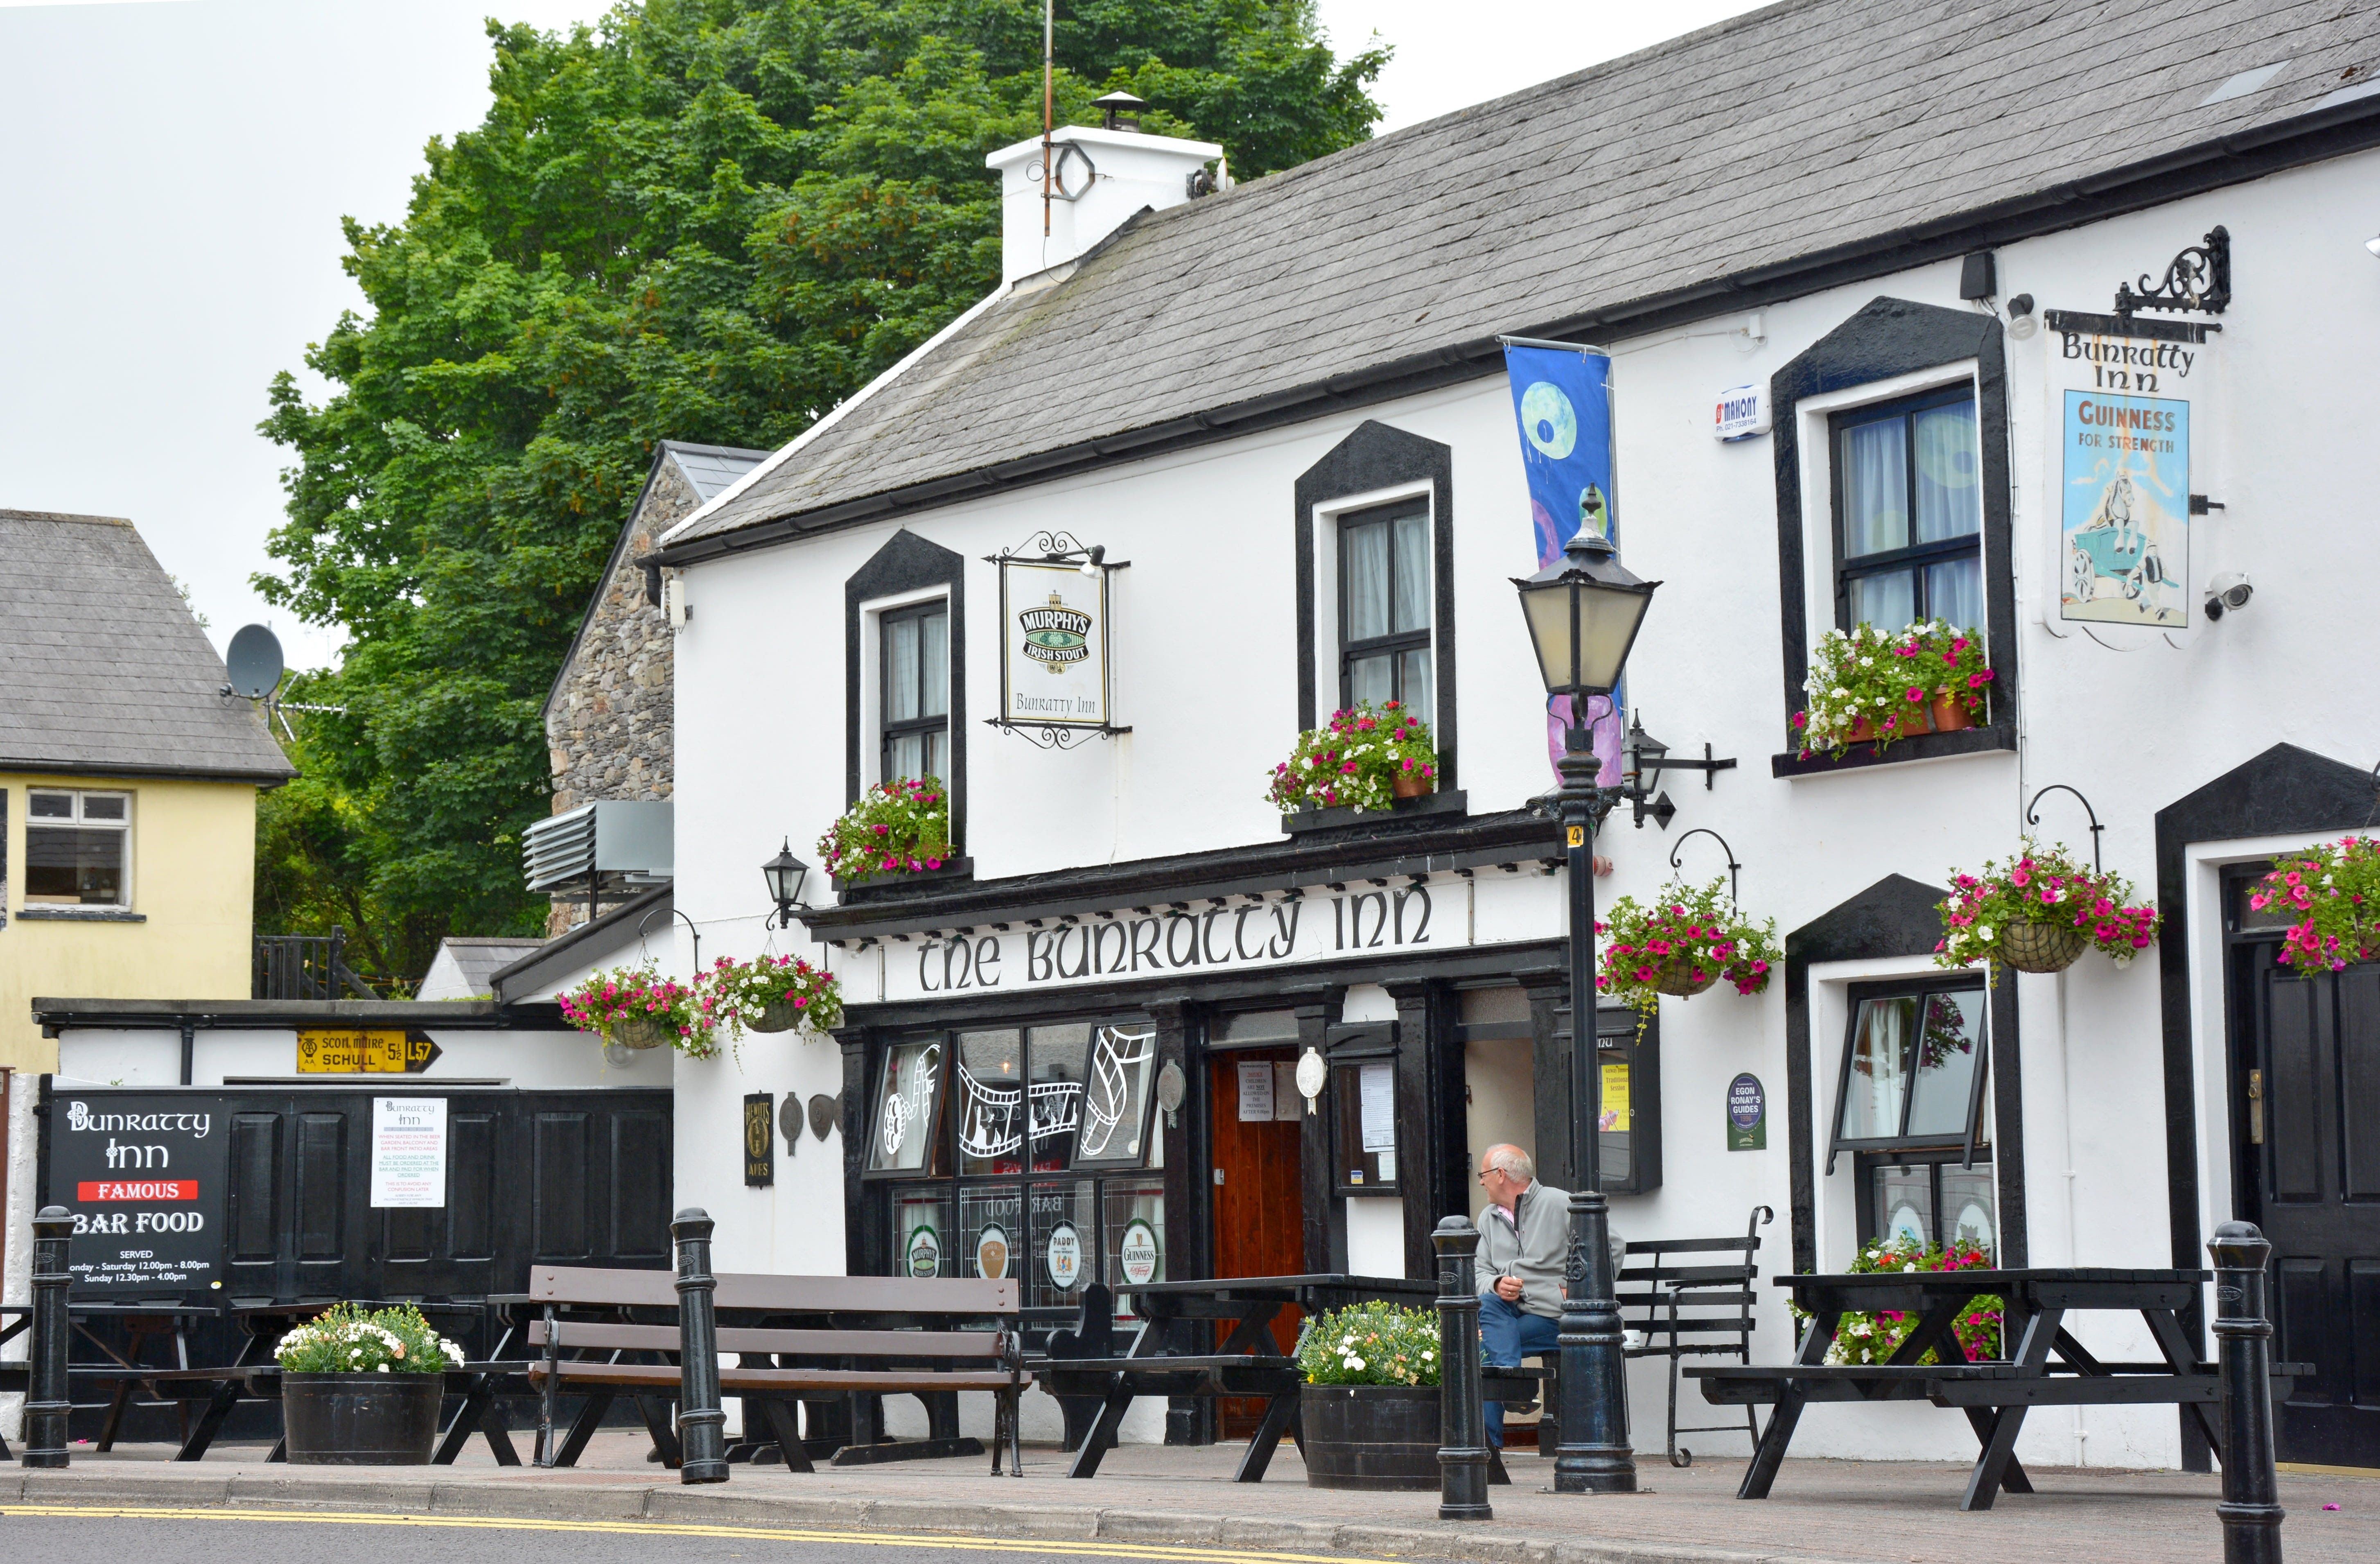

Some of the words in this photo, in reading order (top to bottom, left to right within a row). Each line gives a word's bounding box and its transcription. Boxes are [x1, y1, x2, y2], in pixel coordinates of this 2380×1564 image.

[2095, 365, 2159, 392] Inn
[2079, 400, 2175, 432] GUINNESS
[1725, 418, 1757, 430] 021-7338164
[2079, 432, 2102, 447] FOR
[2109, 436, 2174, 453] STRENGTH
[1022, 610, 1088, 634] MURPHY'S
[1027, 644, 1054, 661] IRISH
[1055, 646, 1085, 661] STOUT
[1077, 696, 1095, 713] Inn
[407, 1042, 432, 1060] L57
[323, 1054, 376, 1065] SCHULL
[1736, 1087, 1755, 1095] EGON
[1731, 1096, 1761, 1105] RONAY'S
[1733, 1105, 1759, 1114] GUIDES
[399, 1114, 420, 1125] Inn
[106, 1138, 169, 1168] Inn
[98, 1183, 179, 1199] FAMOUS
[72, 1213, 129, 1235] BAR
[135, 1212, 204, 1234] FOOD
[1053, 1237, 1075, 1246] PADDY
[120, 1250, 153, 1259] SERVED
[1124, 1248, 1154, 1261] GUINNESS
[70, 1263, 94, 1272] onday
[101, 1262, 136, 1272] Saturday
[139, 1261, 172, 1271] 12.00pm
[180, 1261, 210, 1270] 8.00pm
[924, 1268, 935, 1277] STOUT
[84, 1274, 113, 1284] Sunday
[116, 1273, 149, 1283] 12.30pm
[157, 1272, 187, 1282] 4.00pm
